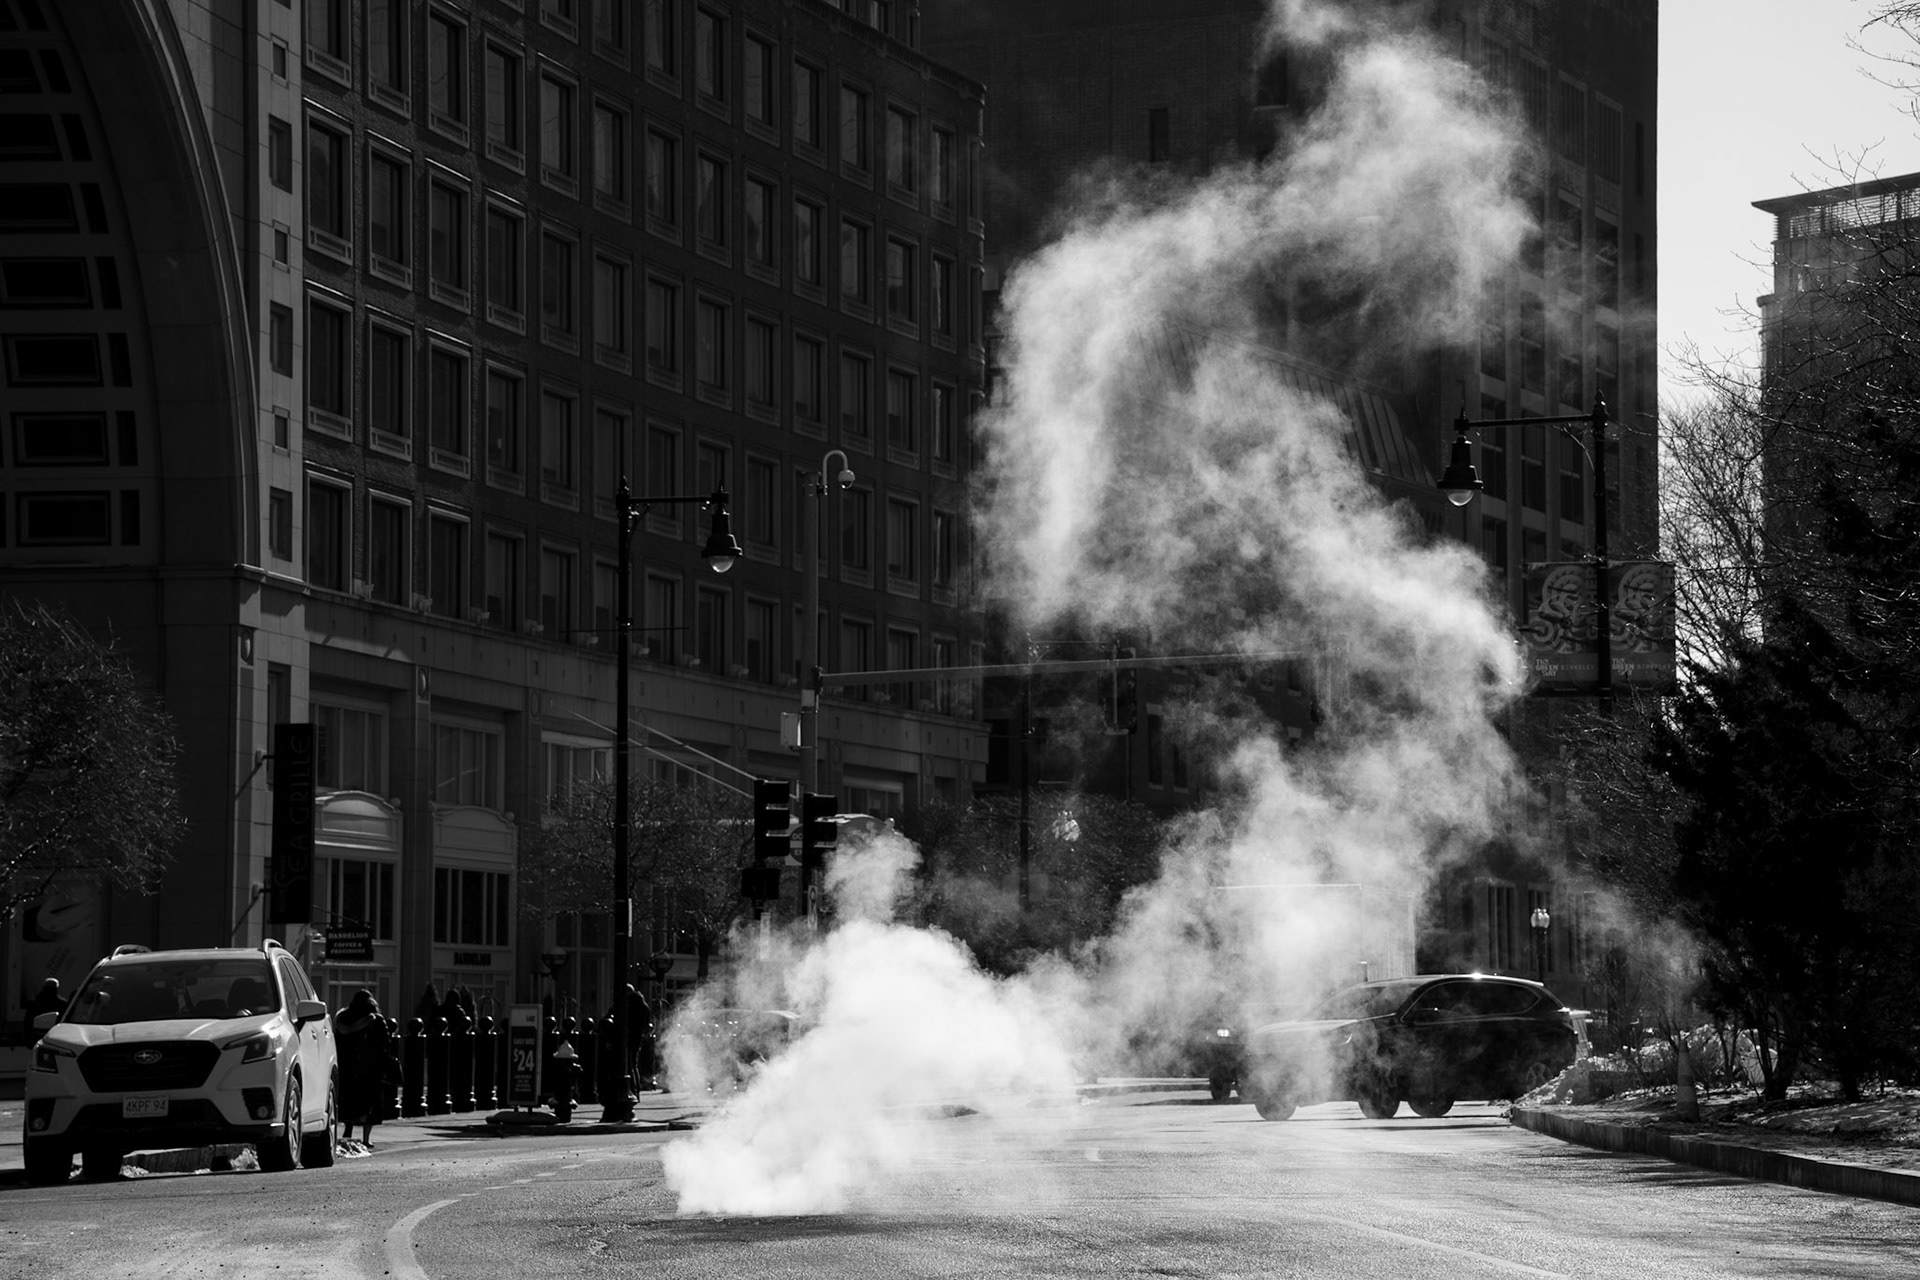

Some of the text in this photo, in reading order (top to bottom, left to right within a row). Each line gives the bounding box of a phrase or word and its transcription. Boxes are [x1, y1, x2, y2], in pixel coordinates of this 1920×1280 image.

[289, 736, 311, 825] GRILLE
[513, 1048, 535, 1072] $24
[126, 1099, 165, 1112] 4KPF 94
